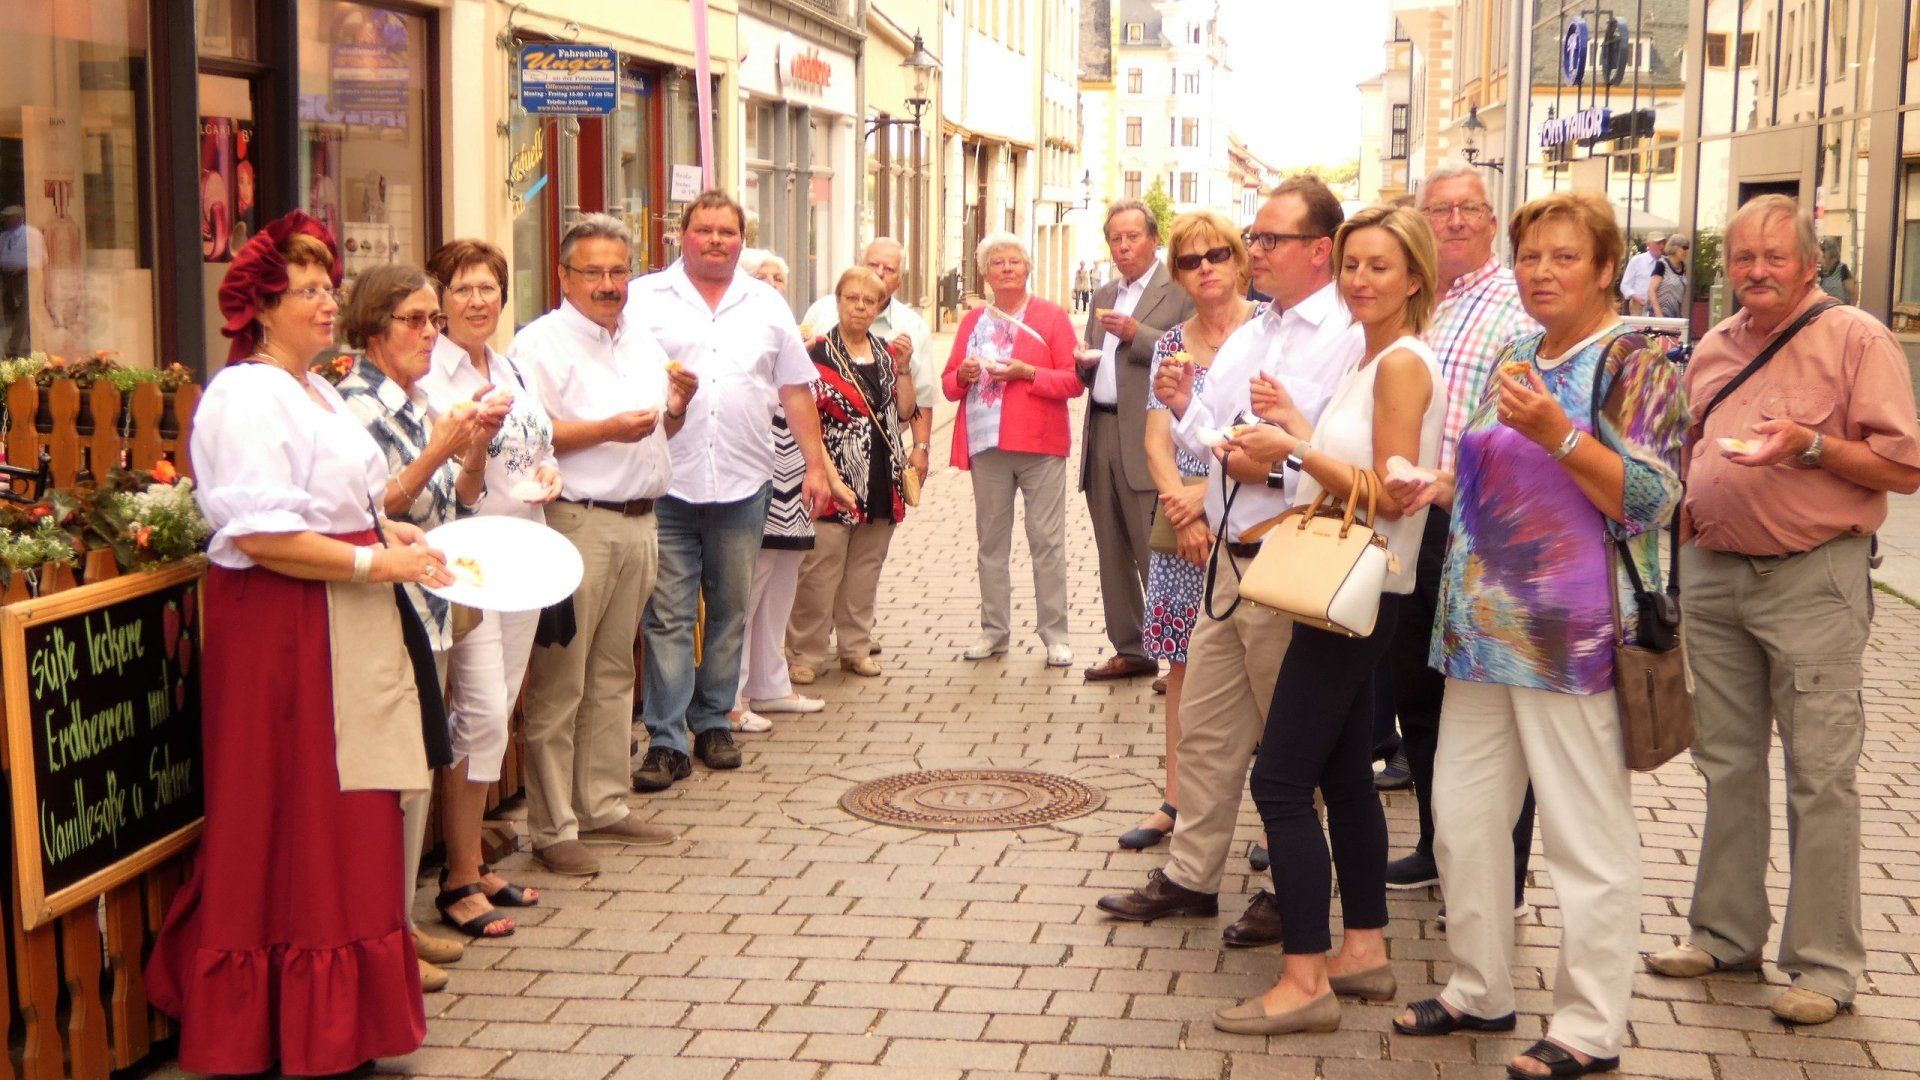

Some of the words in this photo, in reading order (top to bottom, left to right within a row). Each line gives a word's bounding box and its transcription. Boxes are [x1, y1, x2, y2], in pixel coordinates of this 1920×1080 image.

[524, 52, 614, 75] Unger
[558, 48, 609, 58] Fahrschule
[1564, 107, 1605, 141] TAILOR
[31, 626, 79, 708] süße
[84, 610, 145, 677] leckere
[45, 699, 136, 773] Erdbeeren
[147, 658, 171, 729] mit
[41, 769, 127, 866] Vanillesoße
